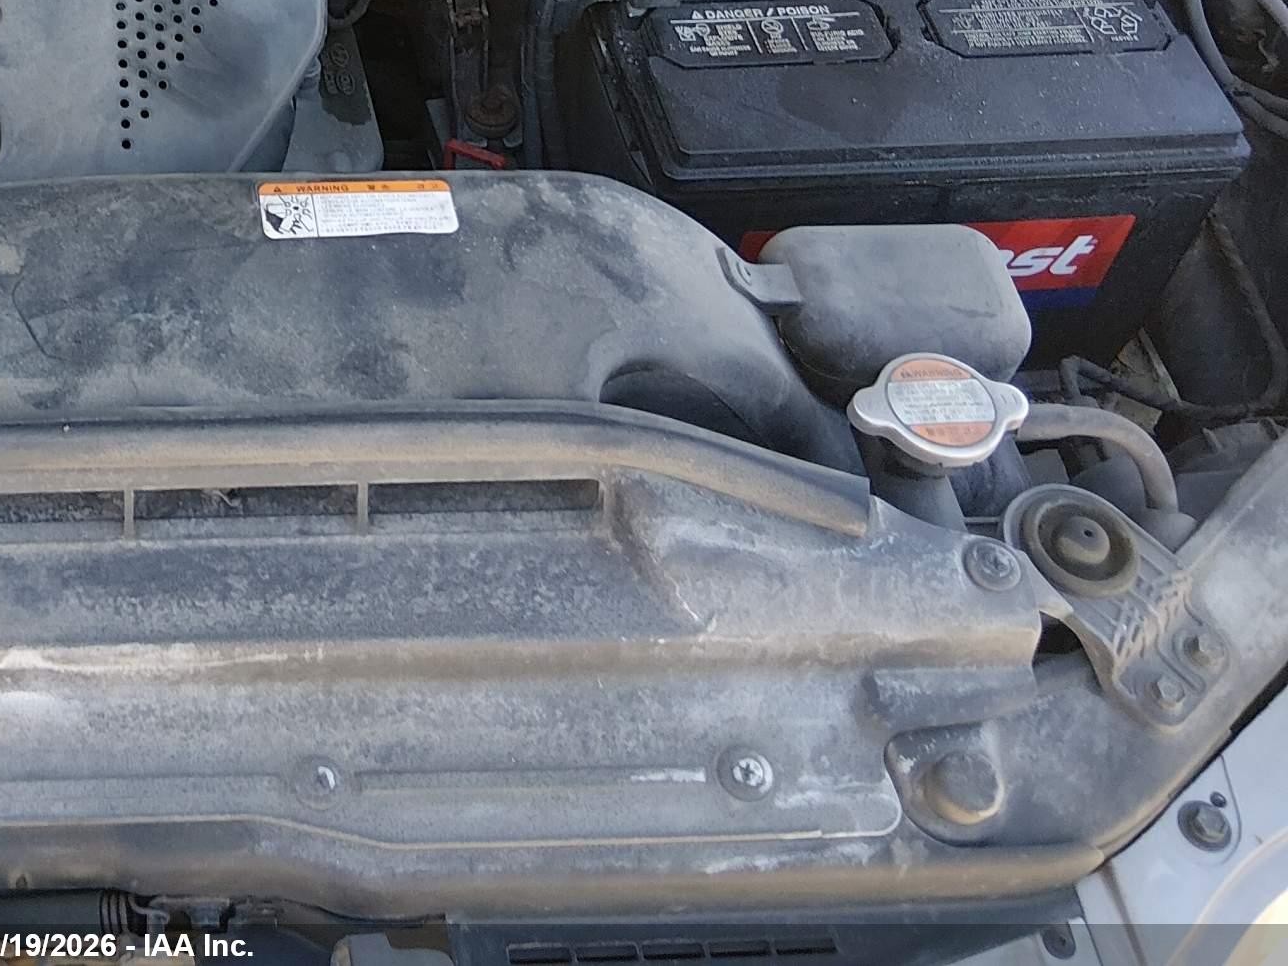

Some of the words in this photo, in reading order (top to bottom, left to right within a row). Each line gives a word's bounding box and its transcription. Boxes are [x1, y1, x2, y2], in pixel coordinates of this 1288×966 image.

[705, 7, 763, 20] DANGER
[777, 4, 830, 17] POISON
[296, 184, 349, 192] WARNING
